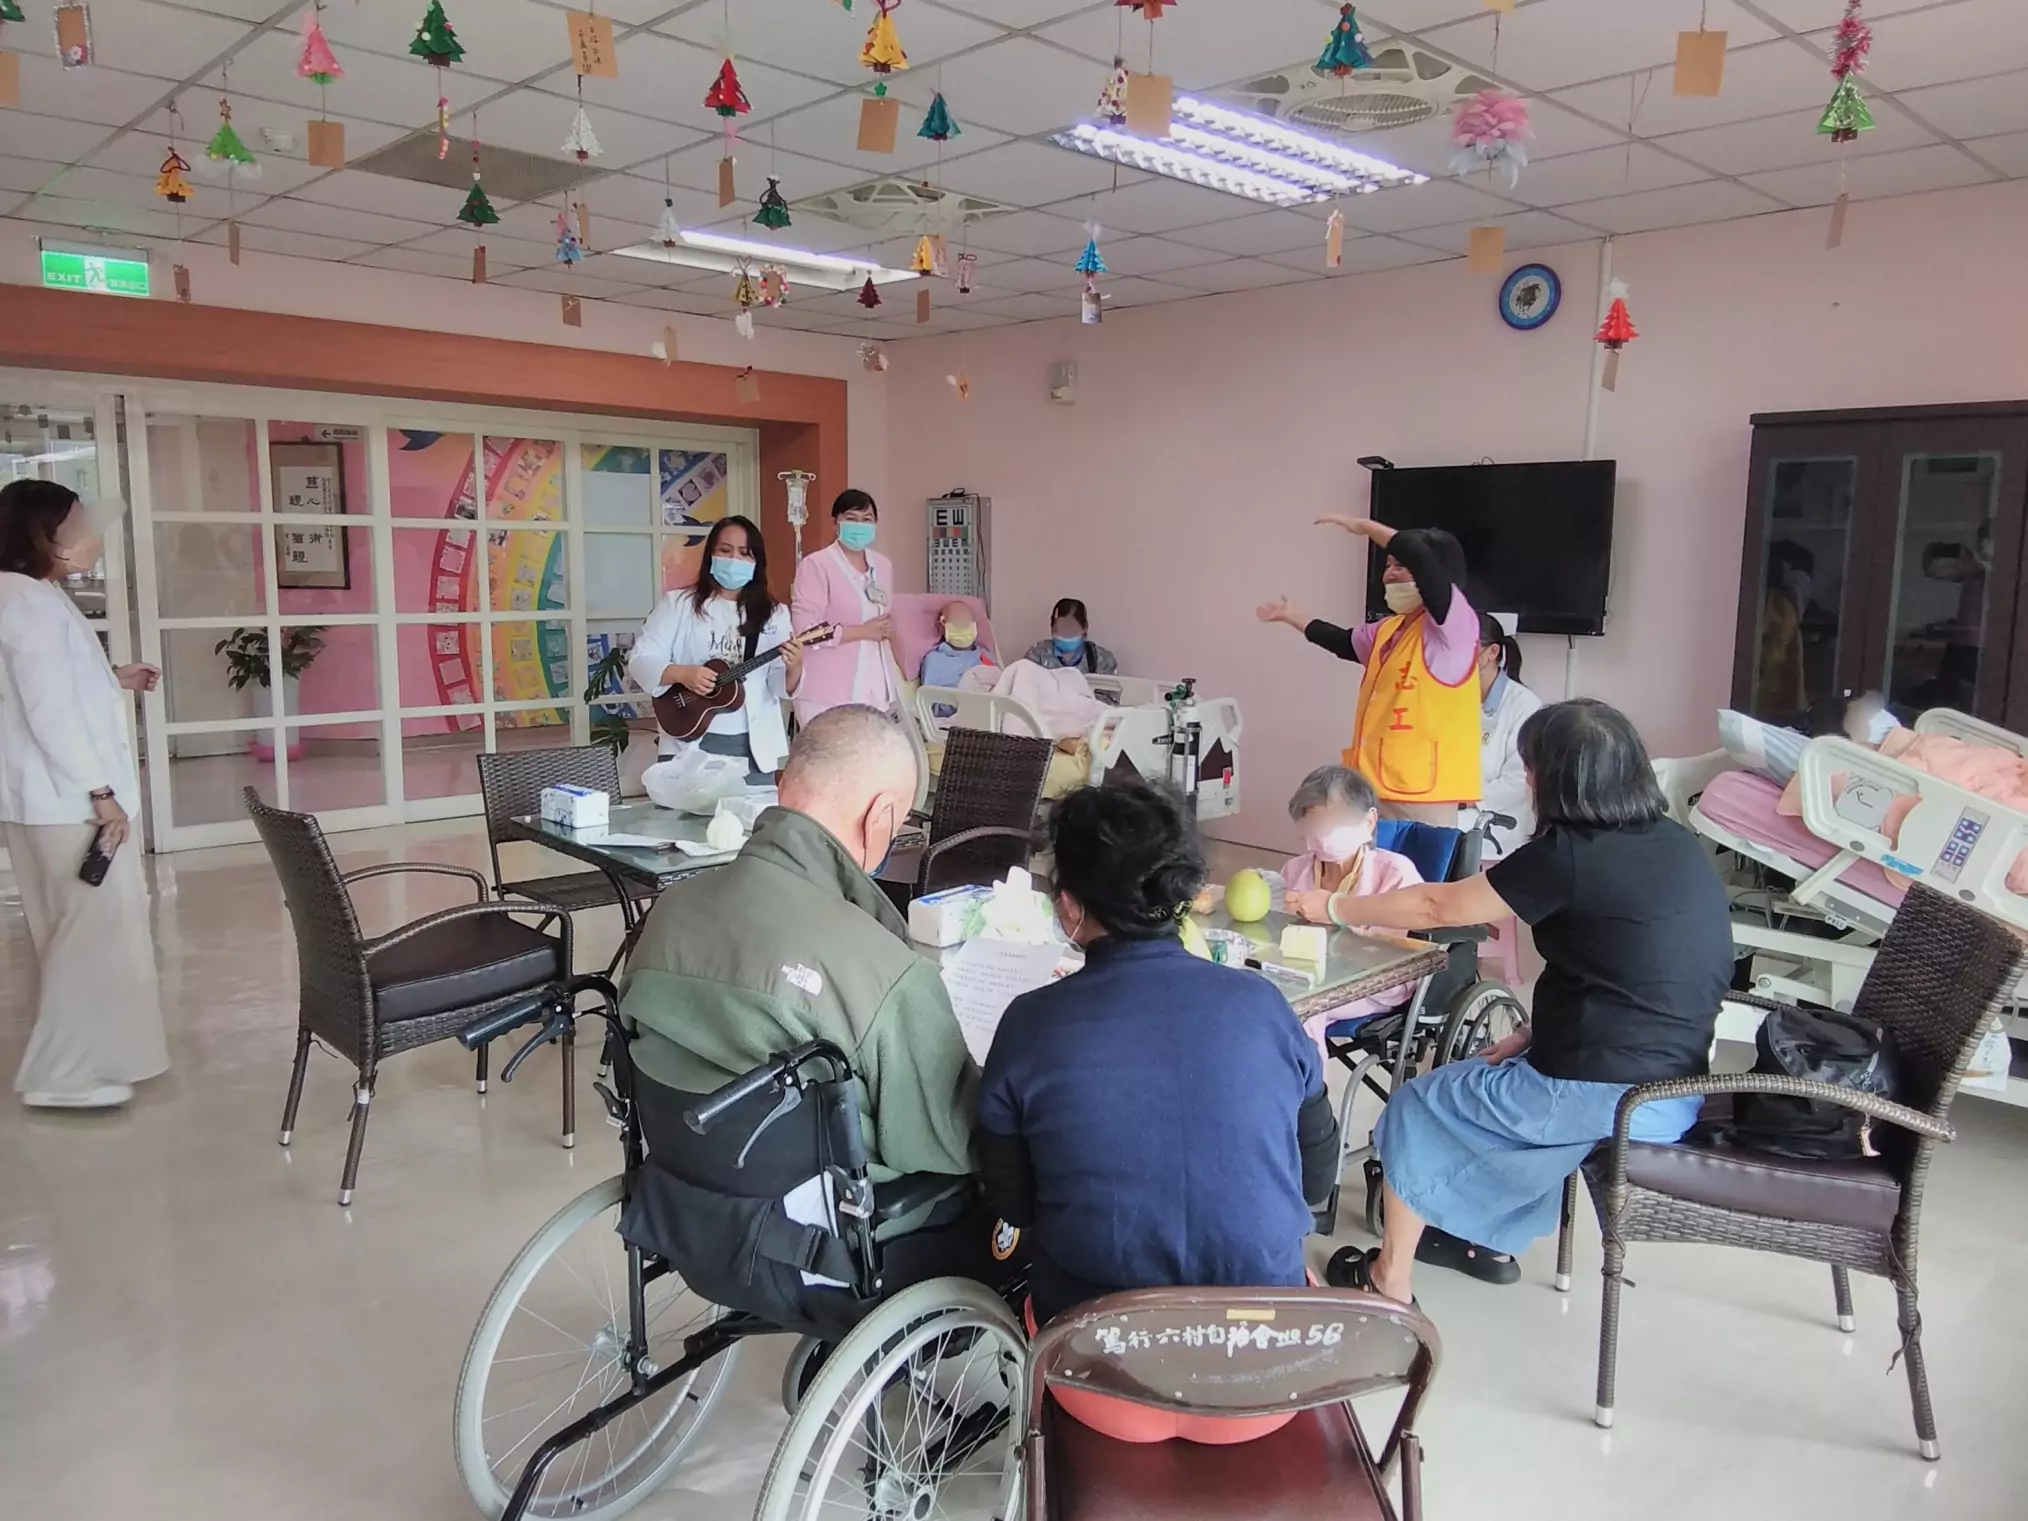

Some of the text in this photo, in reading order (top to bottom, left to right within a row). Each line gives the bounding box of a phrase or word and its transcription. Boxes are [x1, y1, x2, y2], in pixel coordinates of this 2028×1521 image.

[46, 272, 83, 284] EXIT
[1387, 660, 1418, 731] 志工
[1305, 1322, 1344, 1346] 56
